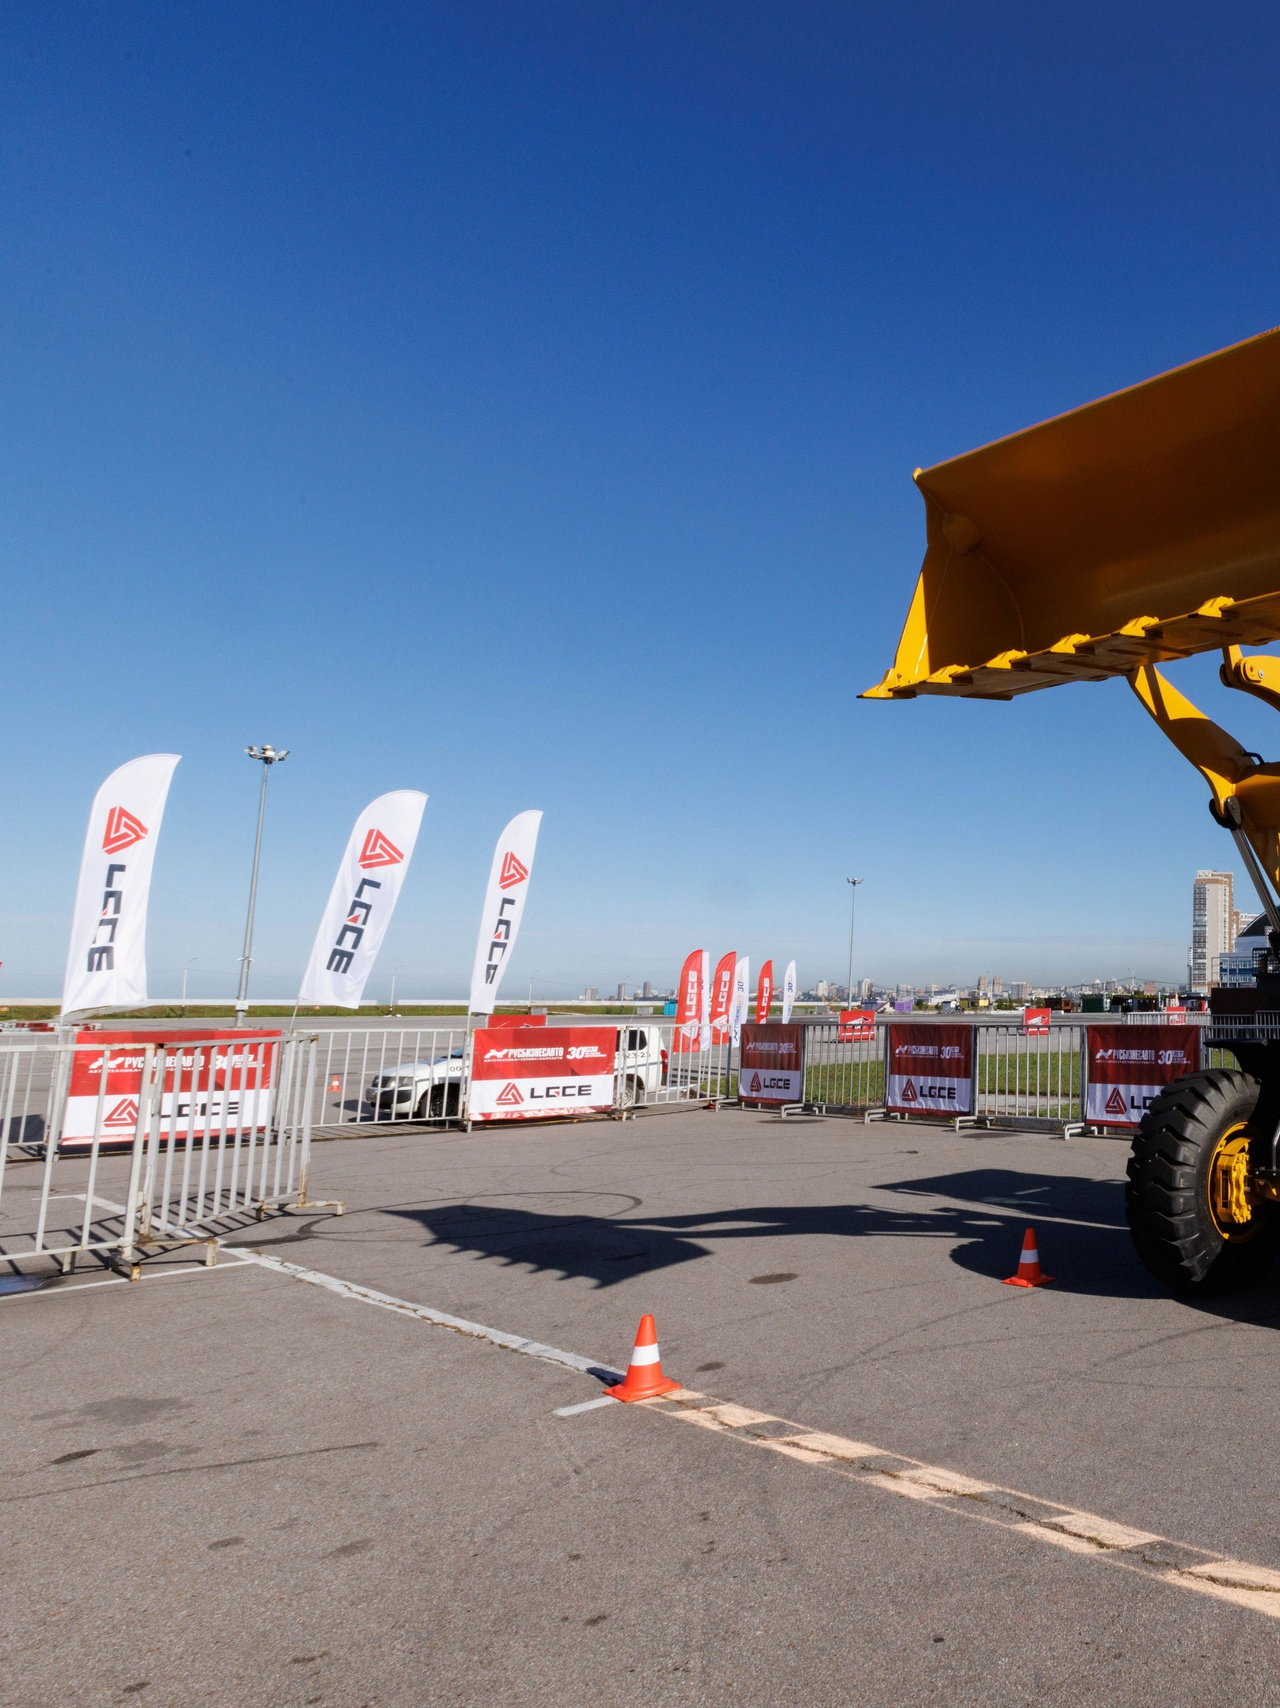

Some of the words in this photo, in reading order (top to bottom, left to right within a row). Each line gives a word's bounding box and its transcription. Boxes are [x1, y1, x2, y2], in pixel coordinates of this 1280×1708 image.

[326, 877, 382, 974] LGCE
[685, 970, 697, 1016] LGCE
[717, 971, 730, 1012] LGCE
[760, 978, 770, 1015] LGCE
[567, 1046, 585, 1059] 30
[940, 1046, 951, 1059] 30
[1158, 1050, 1173, 1065] 30
[763, 1077, 790, 1090] LGCE
[530, 1085, 592, 1099] LGCE
[920, 1085, 956, 1100] LGCE
